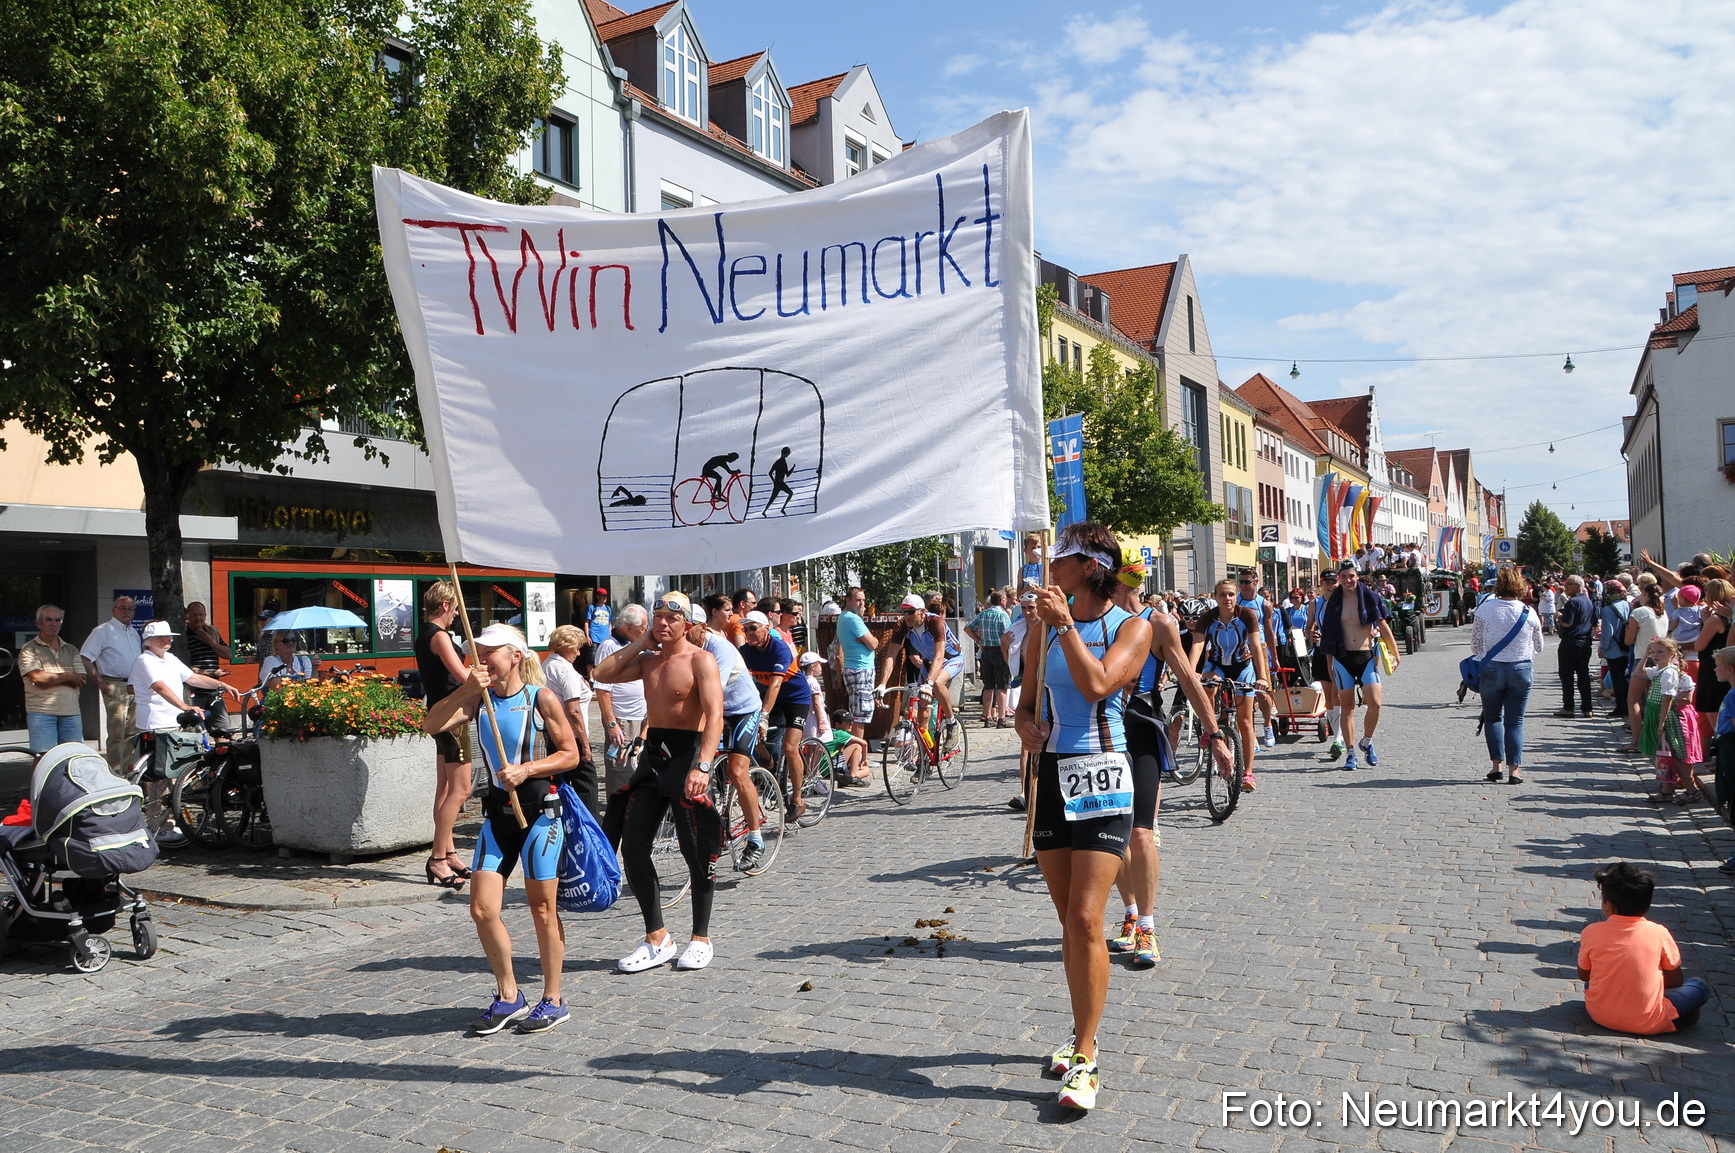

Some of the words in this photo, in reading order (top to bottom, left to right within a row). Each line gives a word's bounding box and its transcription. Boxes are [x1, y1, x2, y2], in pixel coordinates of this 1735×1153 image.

[402, 217, 636, 336] TWin
[657, 163, 1005, 334] Neumarkt
[1085, 759, 1117, 769] Neumarkt
[1067, 767, 1124, 798] 2197
[1083, 798, 1114, 810] Andrea
